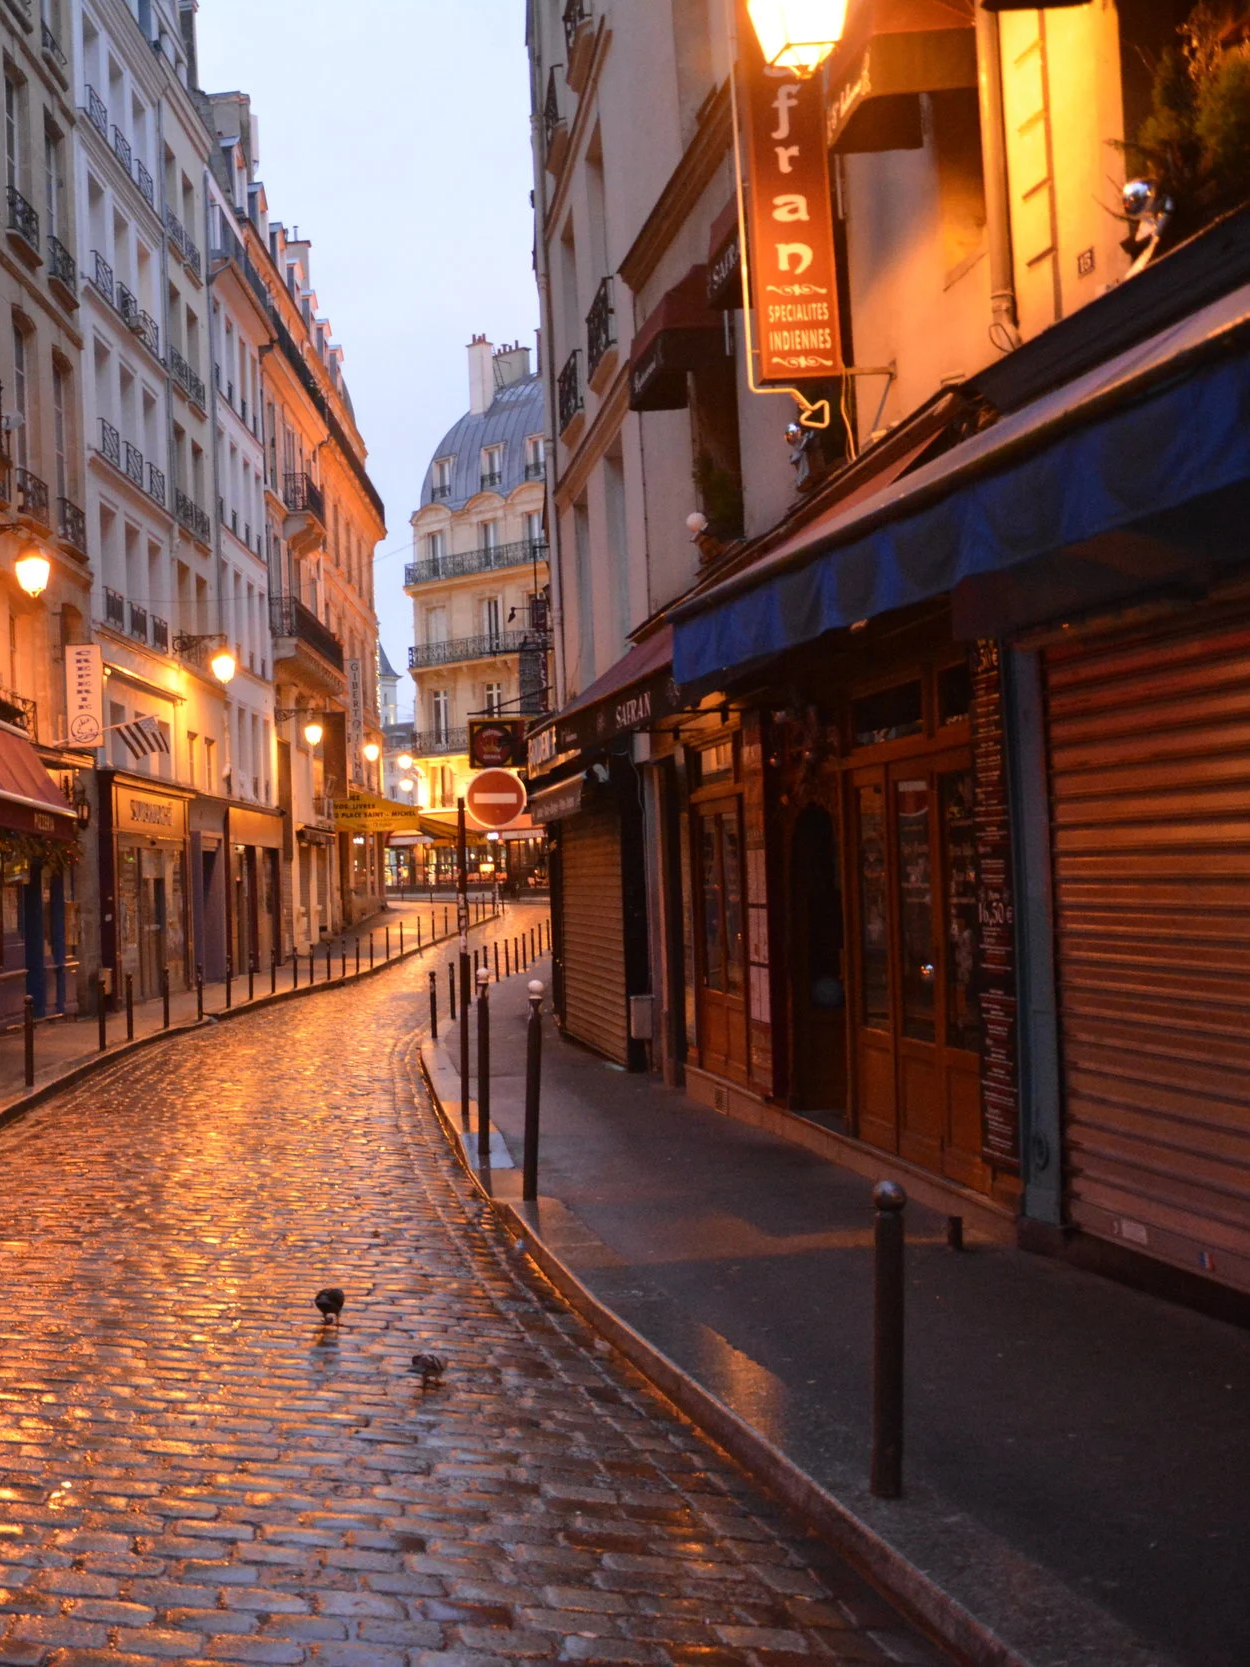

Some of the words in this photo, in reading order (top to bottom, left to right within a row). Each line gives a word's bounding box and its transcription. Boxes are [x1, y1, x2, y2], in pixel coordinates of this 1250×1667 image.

[764, 66, 814, 275] fran
[768, 302, 830, 323] SPECIALITES
[769, 328, 832, 351] INDIENNES
[350, 662, 359, 715] GIBERT
[615, 691, 651, 729] SAFRAN
[391, 810, 417, 818] MICHEL
